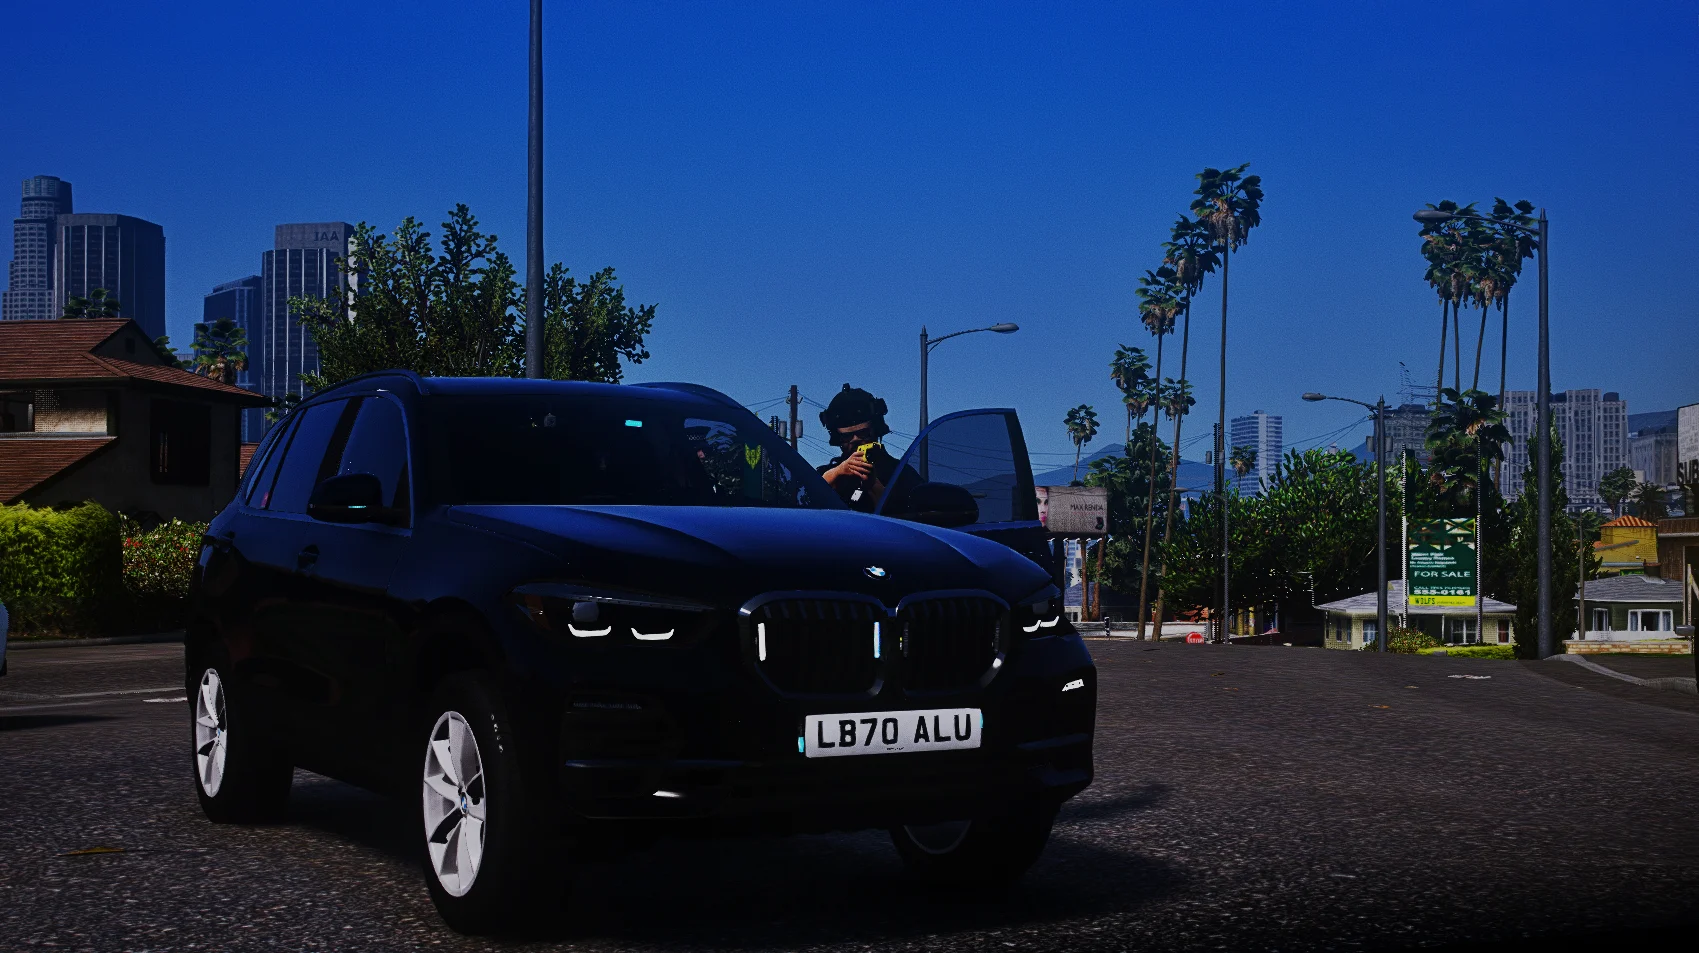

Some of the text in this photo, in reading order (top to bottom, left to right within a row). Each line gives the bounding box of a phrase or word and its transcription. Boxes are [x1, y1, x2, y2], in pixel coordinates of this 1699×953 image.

[314, 231, 339, 241] IAA
[818, 713, 972, 748] LB70 ALU
